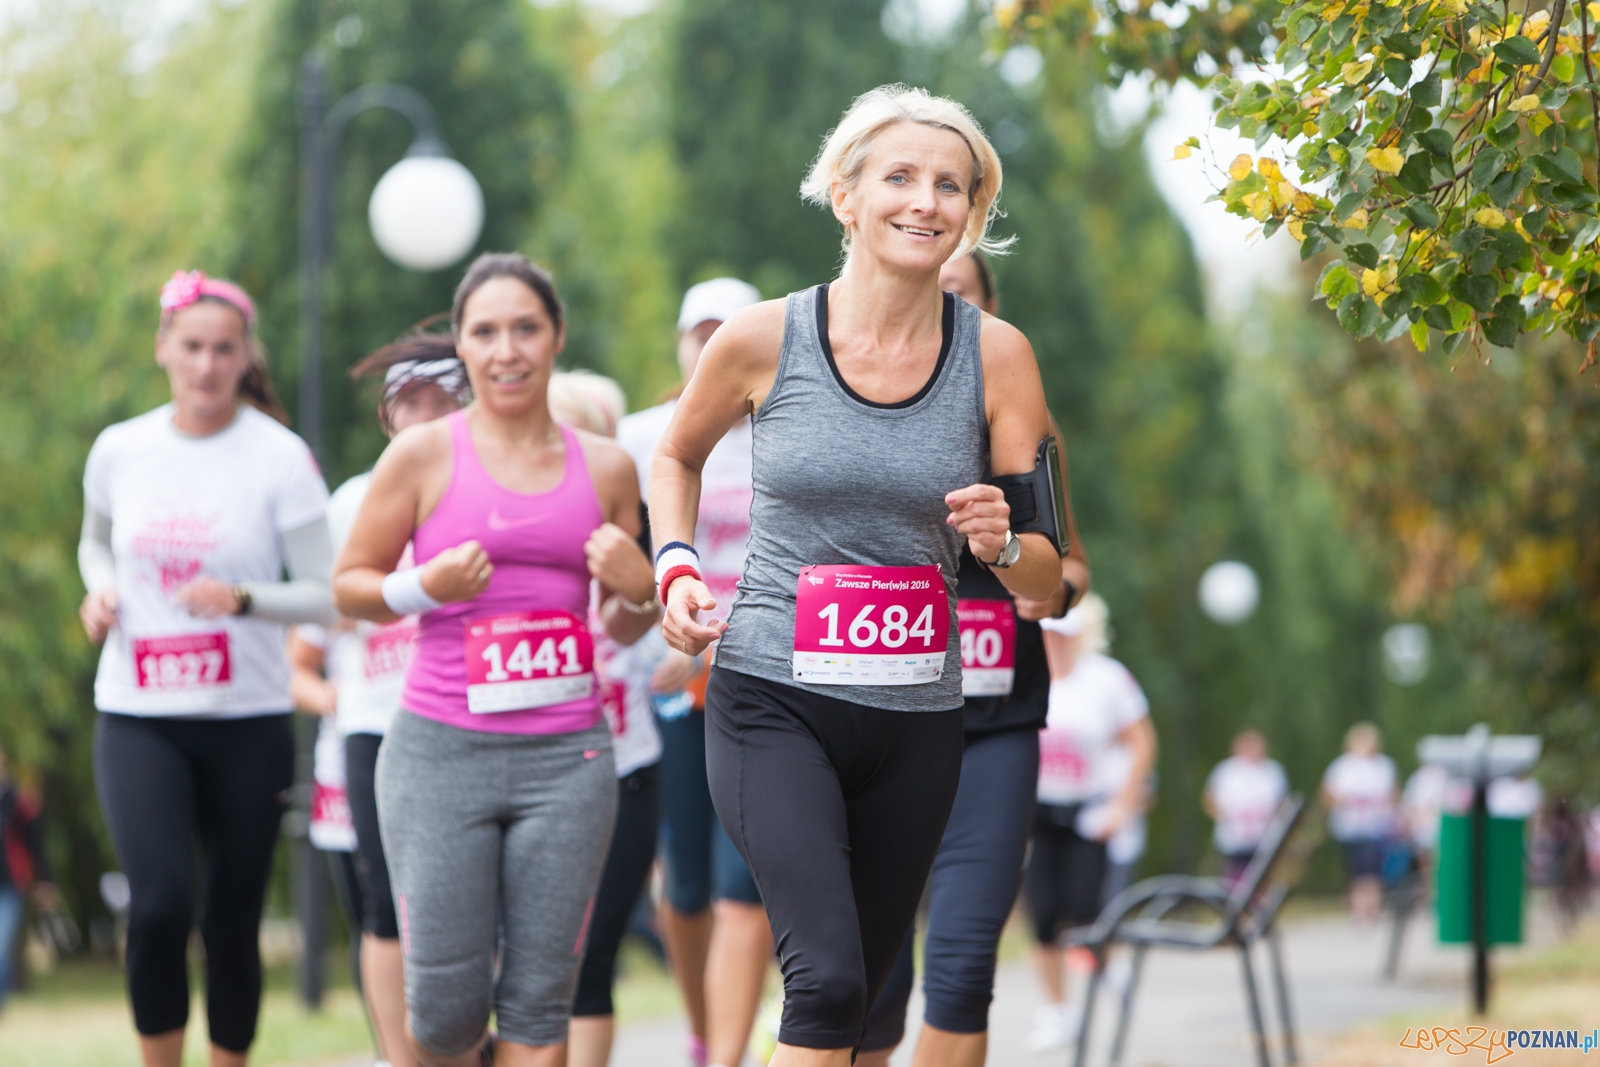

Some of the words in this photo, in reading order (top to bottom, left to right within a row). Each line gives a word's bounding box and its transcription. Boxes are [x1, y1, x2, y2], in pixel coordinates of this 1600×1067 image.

[834, 578, 870, 589] Zawsze
[871, 580, 909, 592] Pier(w)si
[910, 580, 930, 590] 2016
[817, 602, 936, 648] 1684
[482, 635, 584, 682] 1441
